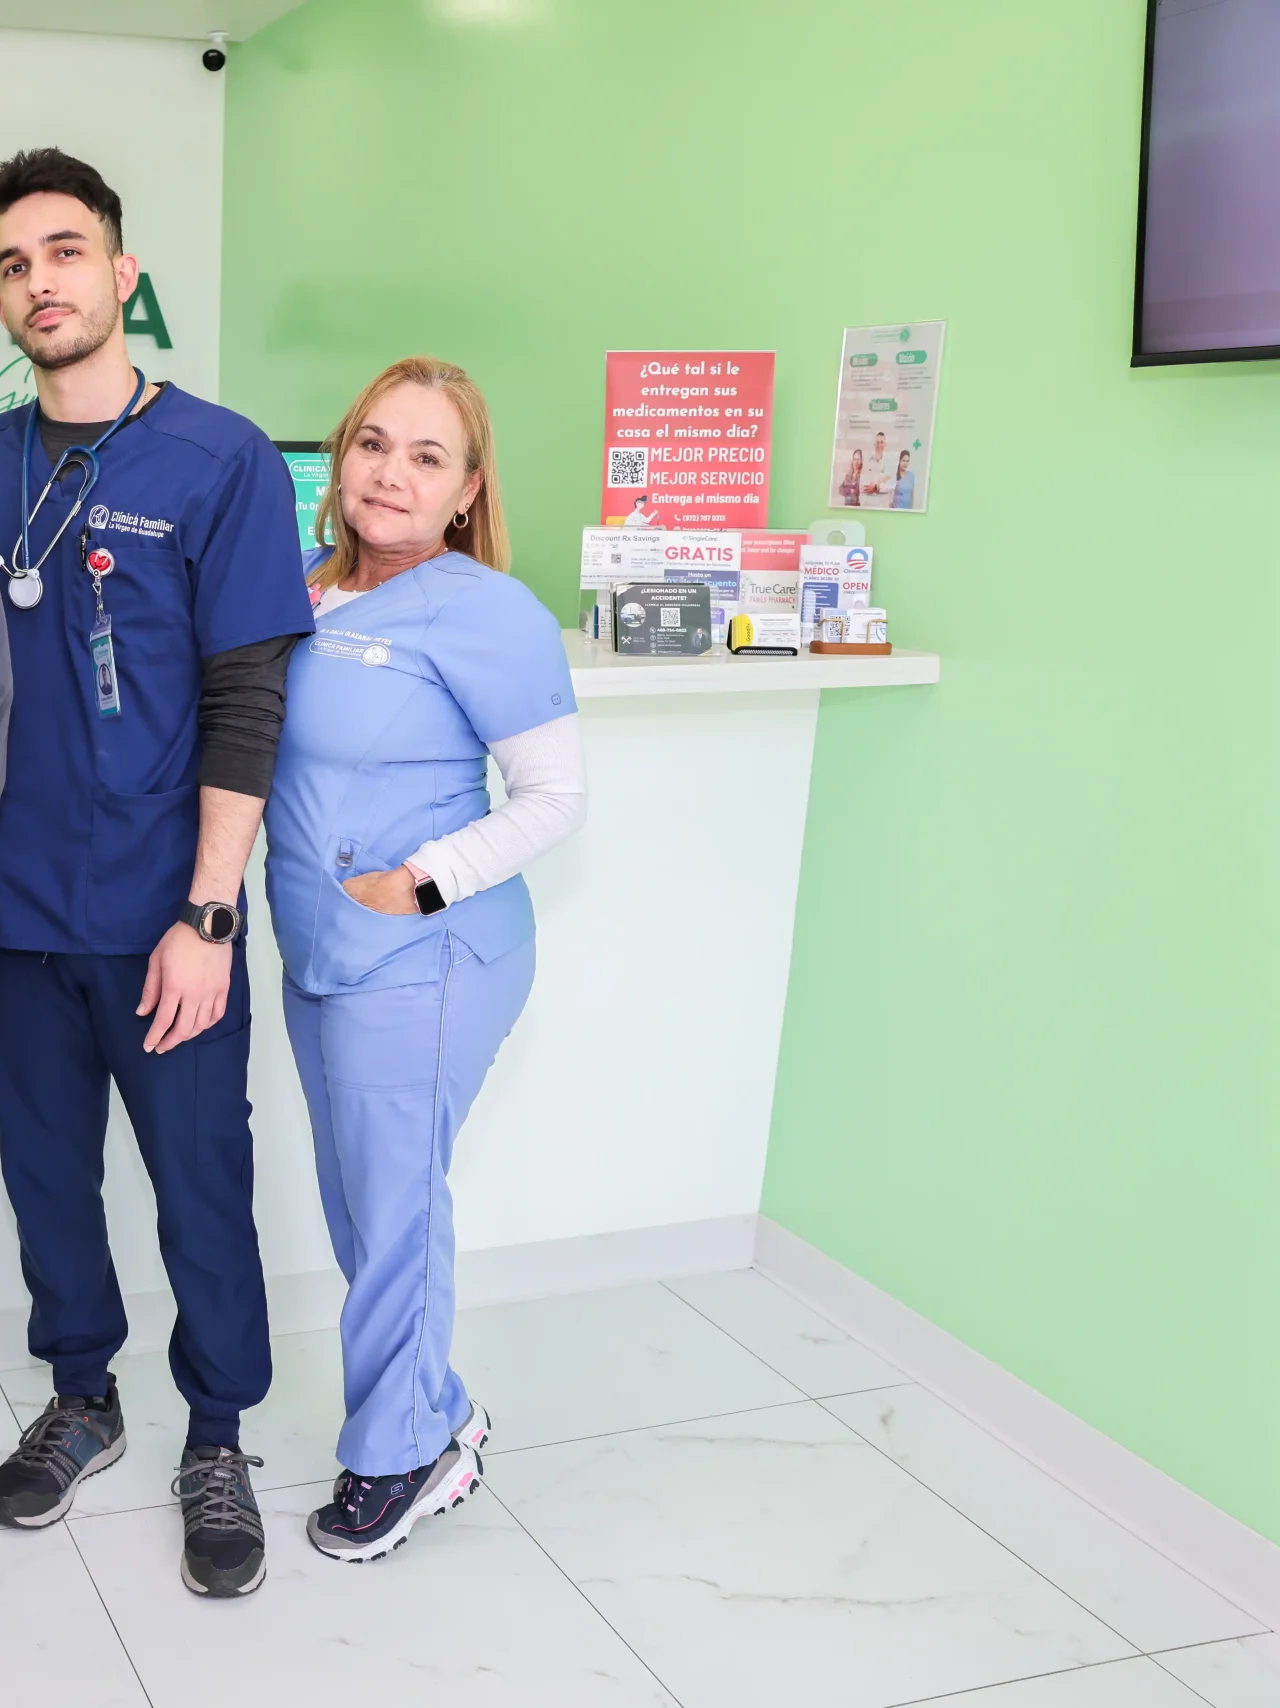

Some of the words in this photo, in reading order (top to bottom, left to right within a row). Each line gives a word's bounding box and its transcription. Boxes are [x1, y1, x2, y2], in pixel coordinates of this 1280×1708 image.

[640, 361, 680, 378] ¿Qué
[684, 361, 704, 375] tal
[710, 362, 721, 375] si
[727, 361, 740, 375] le
[641, 384, 708, 399] entregan
[714, 386, 737, 396] sus
[612, 403, 719, 417] medicamentos
[724, 408, 742, 417] en
[748, 408, 764, 417] su
[617, 428, 650, 438] casa
[656, 424, 668, 438] el
[674, 425, 721, 438] mismo
[726, 424, 758, 438] día?
[651, 448, 703, 463] MEJOR
[708, 448, 765, 463] PRECIO
[650, 472, 697, 485] MEJOR
[700, 472, 764, 485] SERVICIO
[652, 493, 692, 506] Entrega
[694, 493, 704, 504] el
[706, 494, 741, 504] mismo
[111, 511, 138, 527] Clínica
[140, 517, 174, 532] Familiar
[115, 523, 130, 532] Virgen
[138, 528, 164, 538] Guadalupe
[665, 546, 733, 561] GRATIS
[804, 566, 839, 575] MÉDICO
[336, 645, 364, 653] FAMILIAR
